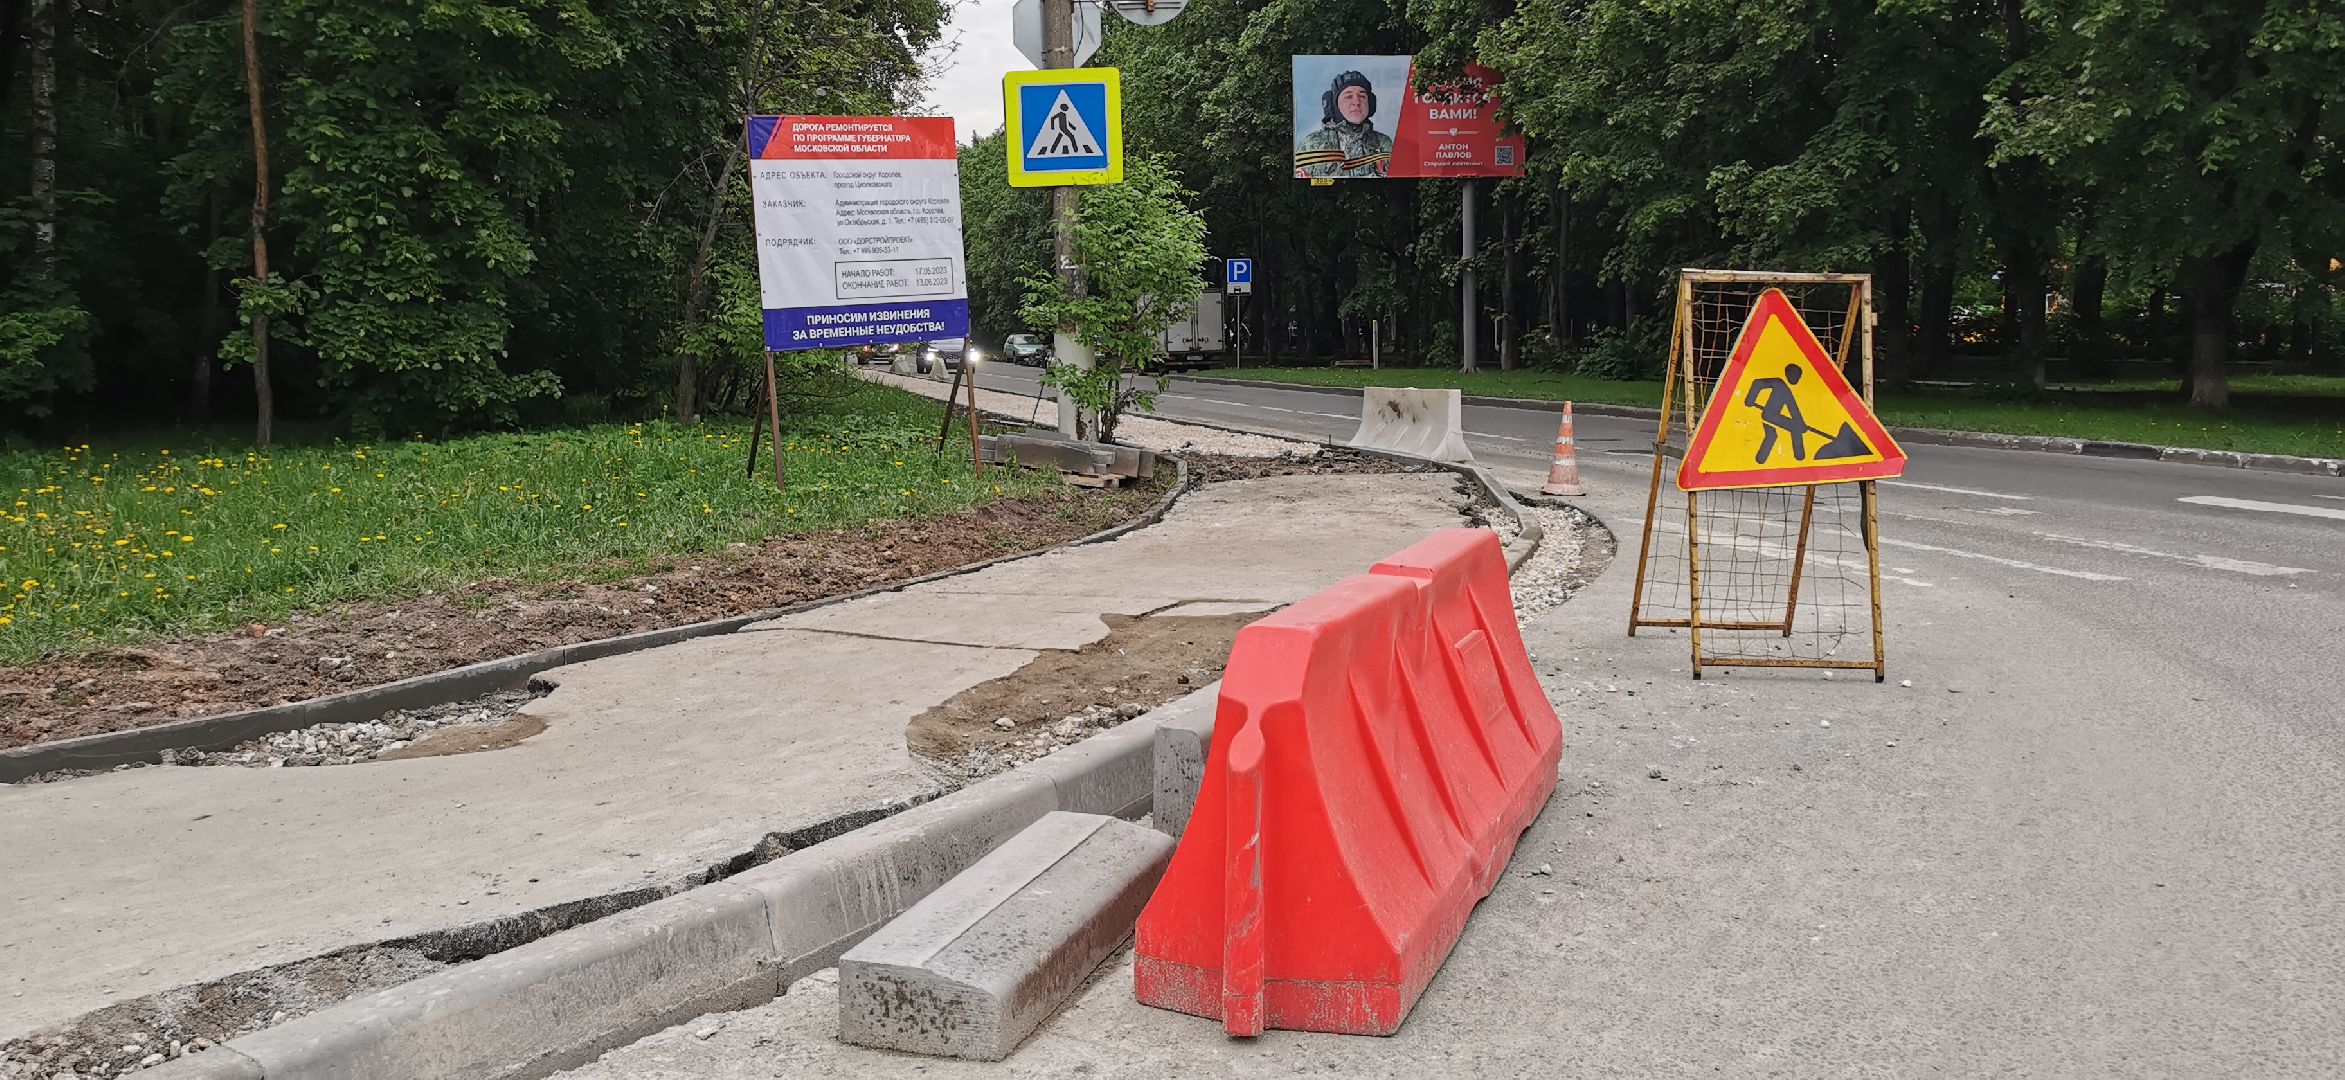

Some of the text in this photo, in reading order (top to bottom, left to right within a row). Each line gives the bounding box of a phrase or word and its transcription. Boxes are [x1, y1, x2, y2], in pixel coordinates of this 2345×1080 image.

[1429, 109, 1477, 119] ВАМИ!
[792, 123, 893, 132] ДОРОГА РЕМОНТИРУЕТСЯ
[792, 134, 911, 142] ПО ПРОГРАММЕ ГУБЕРНАТОРА
[794, 144, 849, 152] МОСКОВСКОЙ
[760, 172, 787, 180] АДРЕС
[762, 200, 807, 208] ЗАКАЗЧИК:
[765, 238, 816, 247] ПОДРЯДЧИК:
[841, 267, 947, 278] НАЧАЛО РАБОТ: 17.05.2023
[1233, 262, 1247, 281] P
[842, 281, 885, 289] ОКОНЧАНИЕ
[807, 309, 930, 325] ПРИНОСИМ ИЗВИНЕНИЯ
[792, 322, 945, 340] ЗА ВРЕМЕННЫЕ НЕУДОБСТВА!
